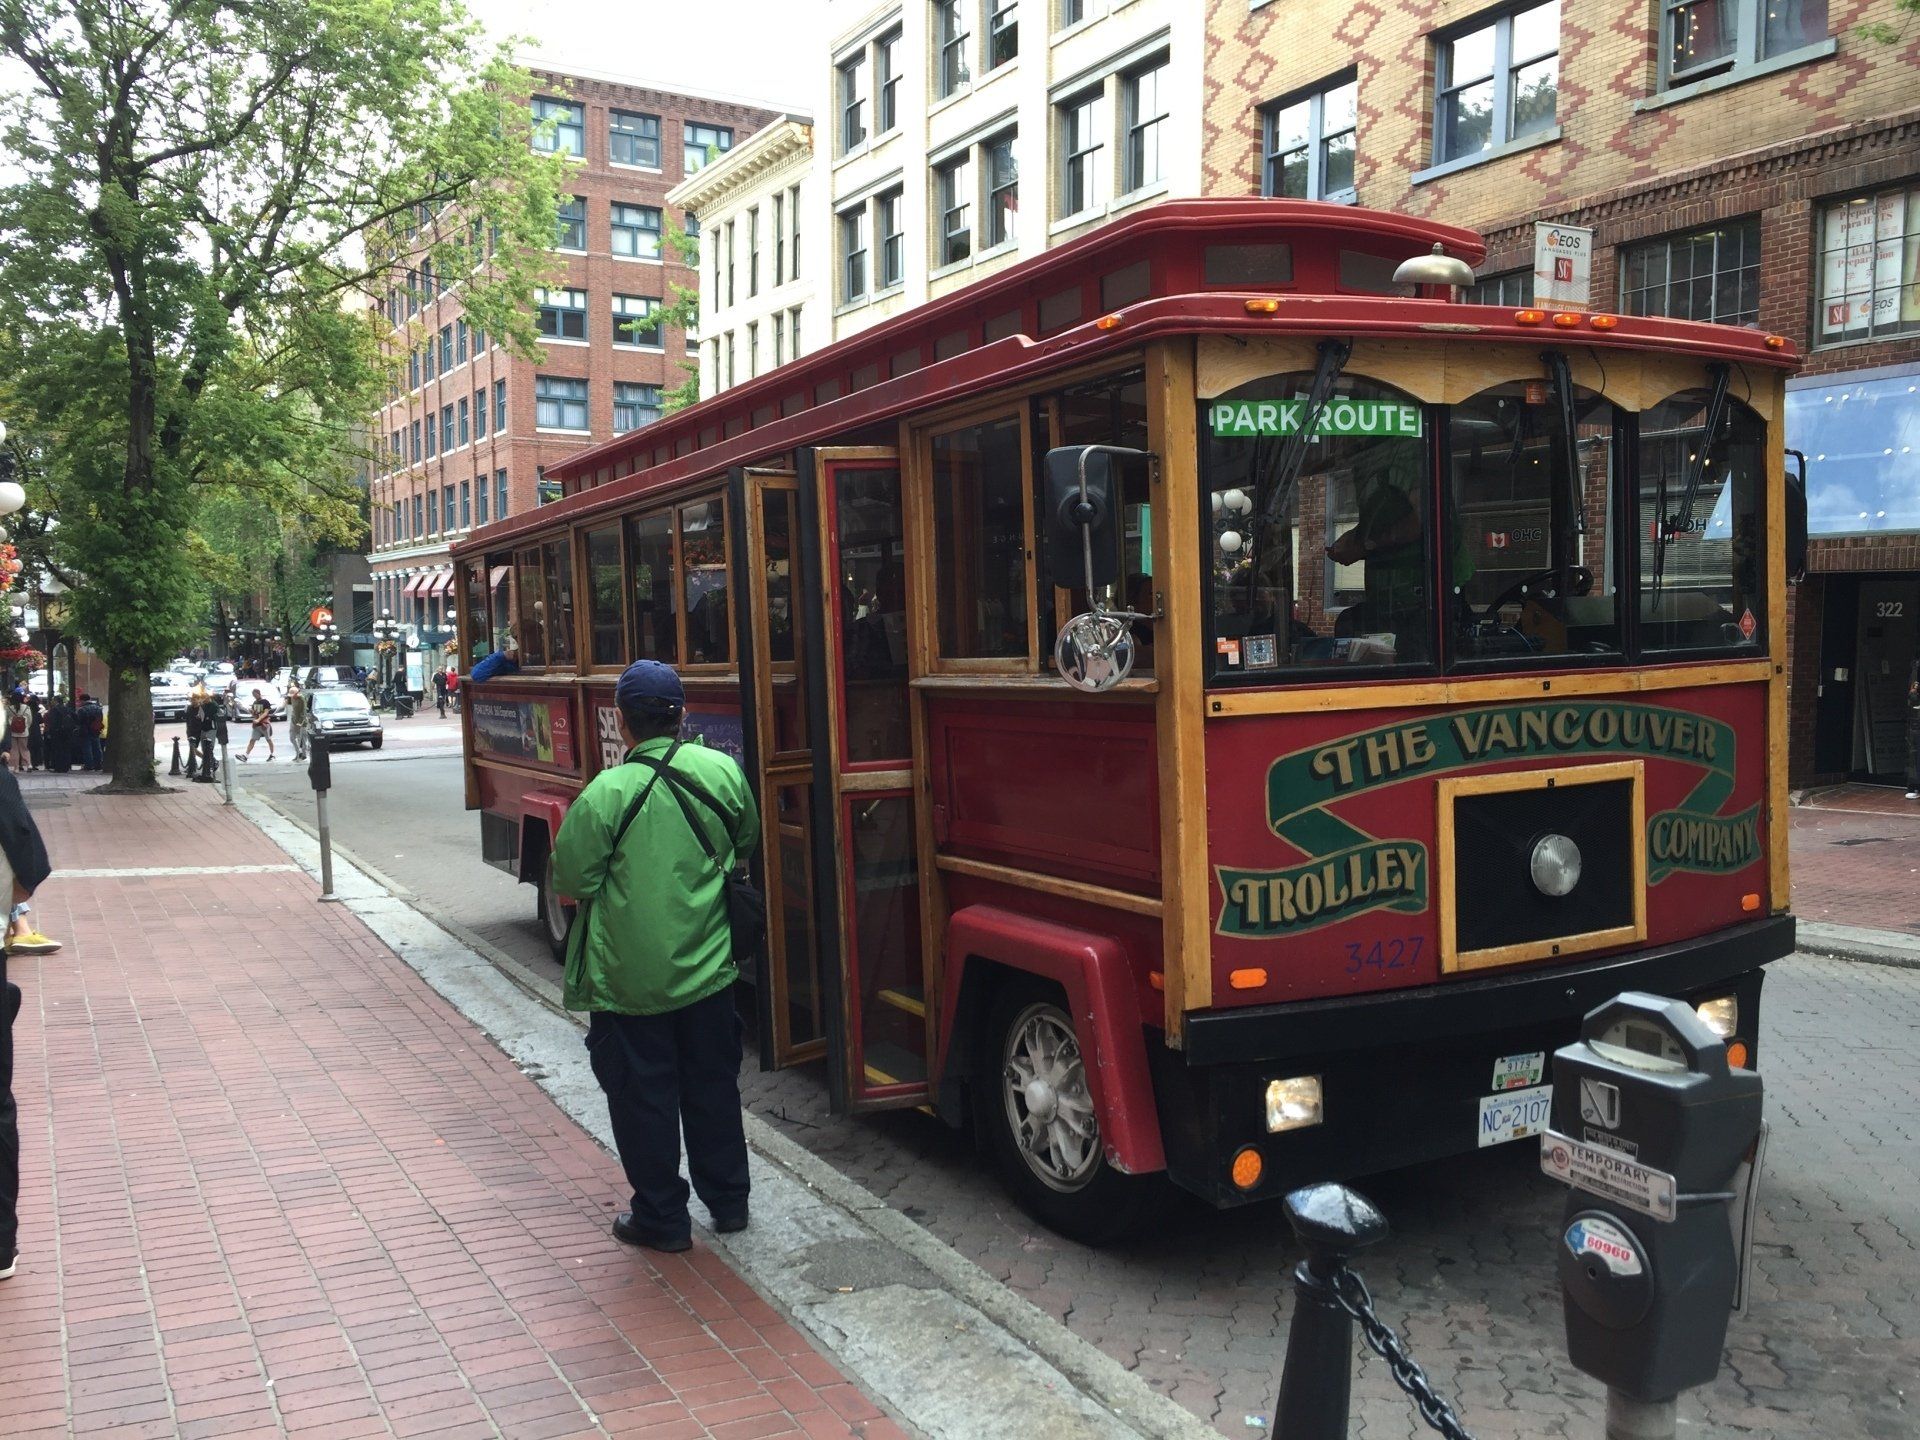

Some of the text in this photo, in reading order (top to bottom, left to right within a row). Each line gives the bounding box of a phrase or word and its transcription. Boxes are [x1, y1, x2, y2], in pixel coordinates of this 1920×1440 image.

[1863, 212, 1893, 226] IETS
[1547, 229, 1581, 248] GEOS
[1558, 260, 1569, 279] SC
[1838, 251, 1894, 268] Peparion
[1216, 404, 1416, 431] PARK ROUTE
[1511, 528, 1542, 542] OHC
[1876, 602, 1903, 617] 322
[1311, 708, 1717, 787] THE VANCOUVER
[1651, 817, 1753, 866] COMPANY
[1228, 848, 1422, 926] TROLLEY
[1344, 936, 1425, 974] 3427
[1507, 1060, 1531, 1072] 9179
[1483, 1109, 1503, 1134] NC
[1511, 1099, 1550, 1128] 2107
[1570, 1145, 1650, 1184] TEMPORARY
[1587, 1236, 1631, 1261] 60960
